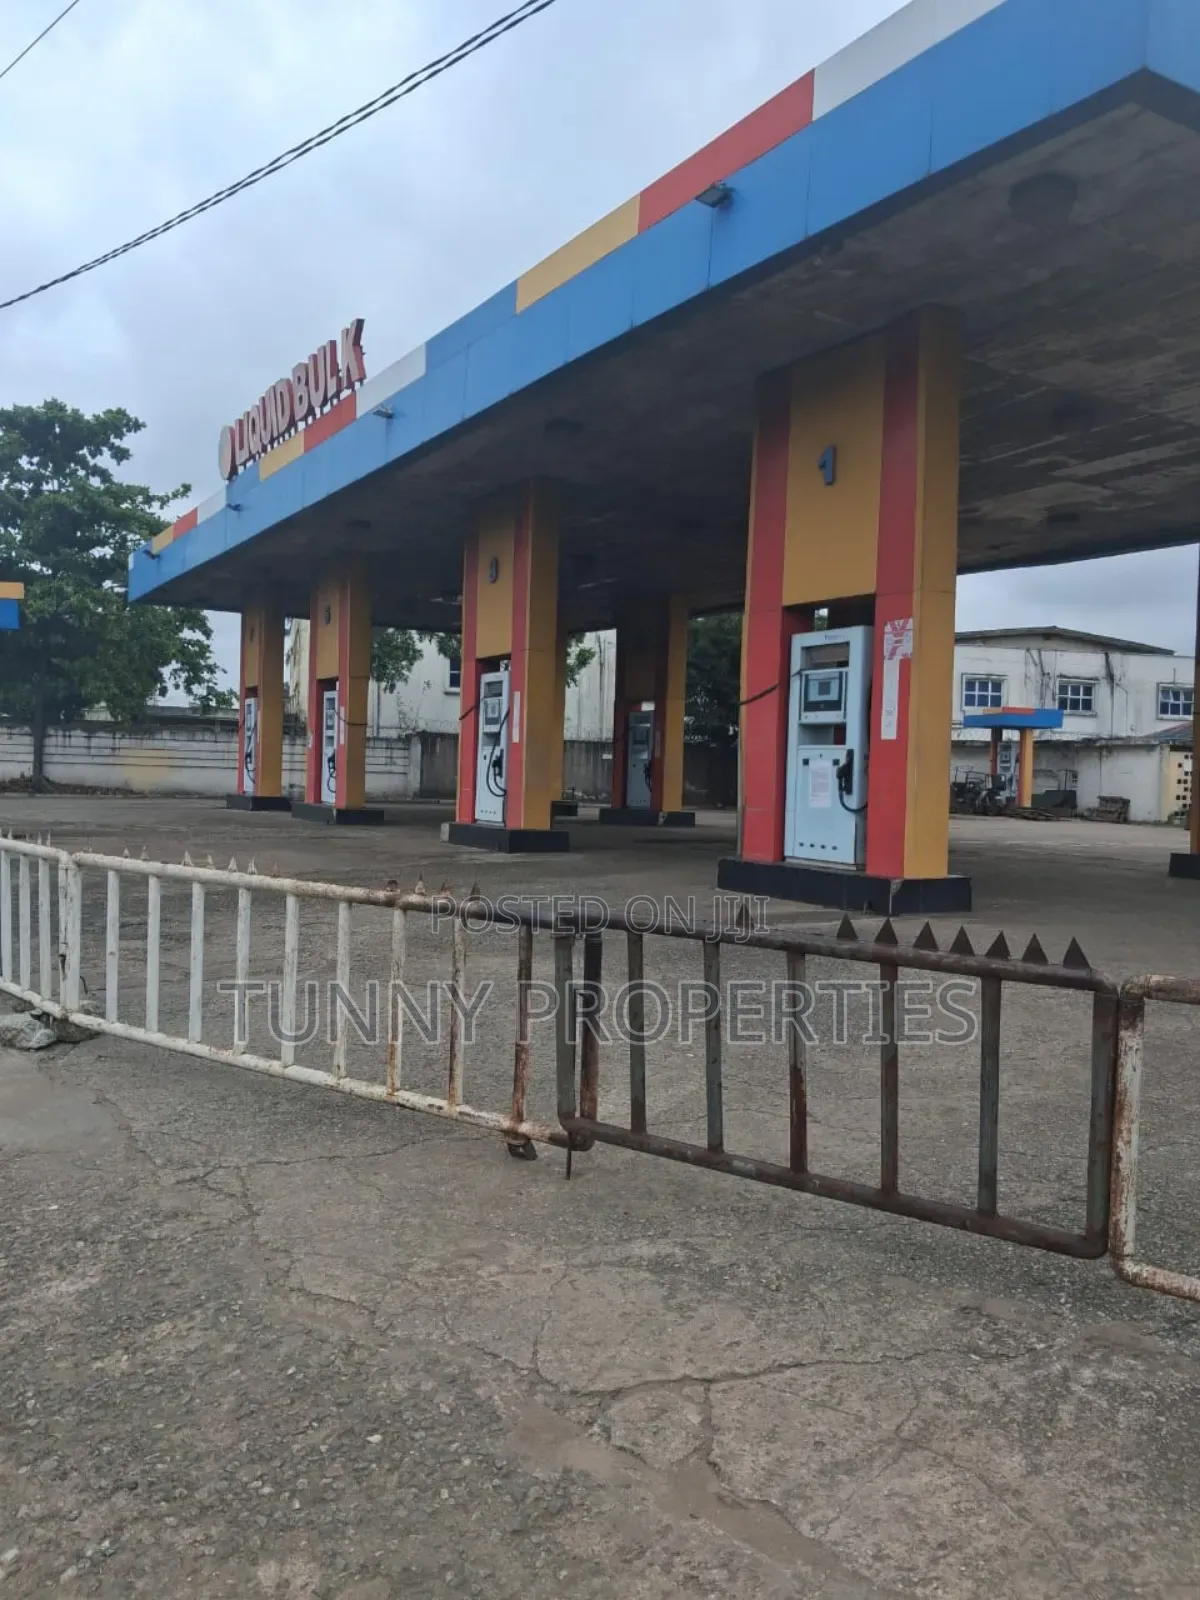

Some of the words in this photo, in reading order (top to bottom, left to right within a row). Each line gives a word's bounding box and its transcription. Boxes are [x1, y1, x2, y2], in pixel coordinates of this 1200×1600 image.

[235, 378, 293, 465] LIQUID
[292, 319, 366, 419] BULK
[816, 445, 836, 486] 1
